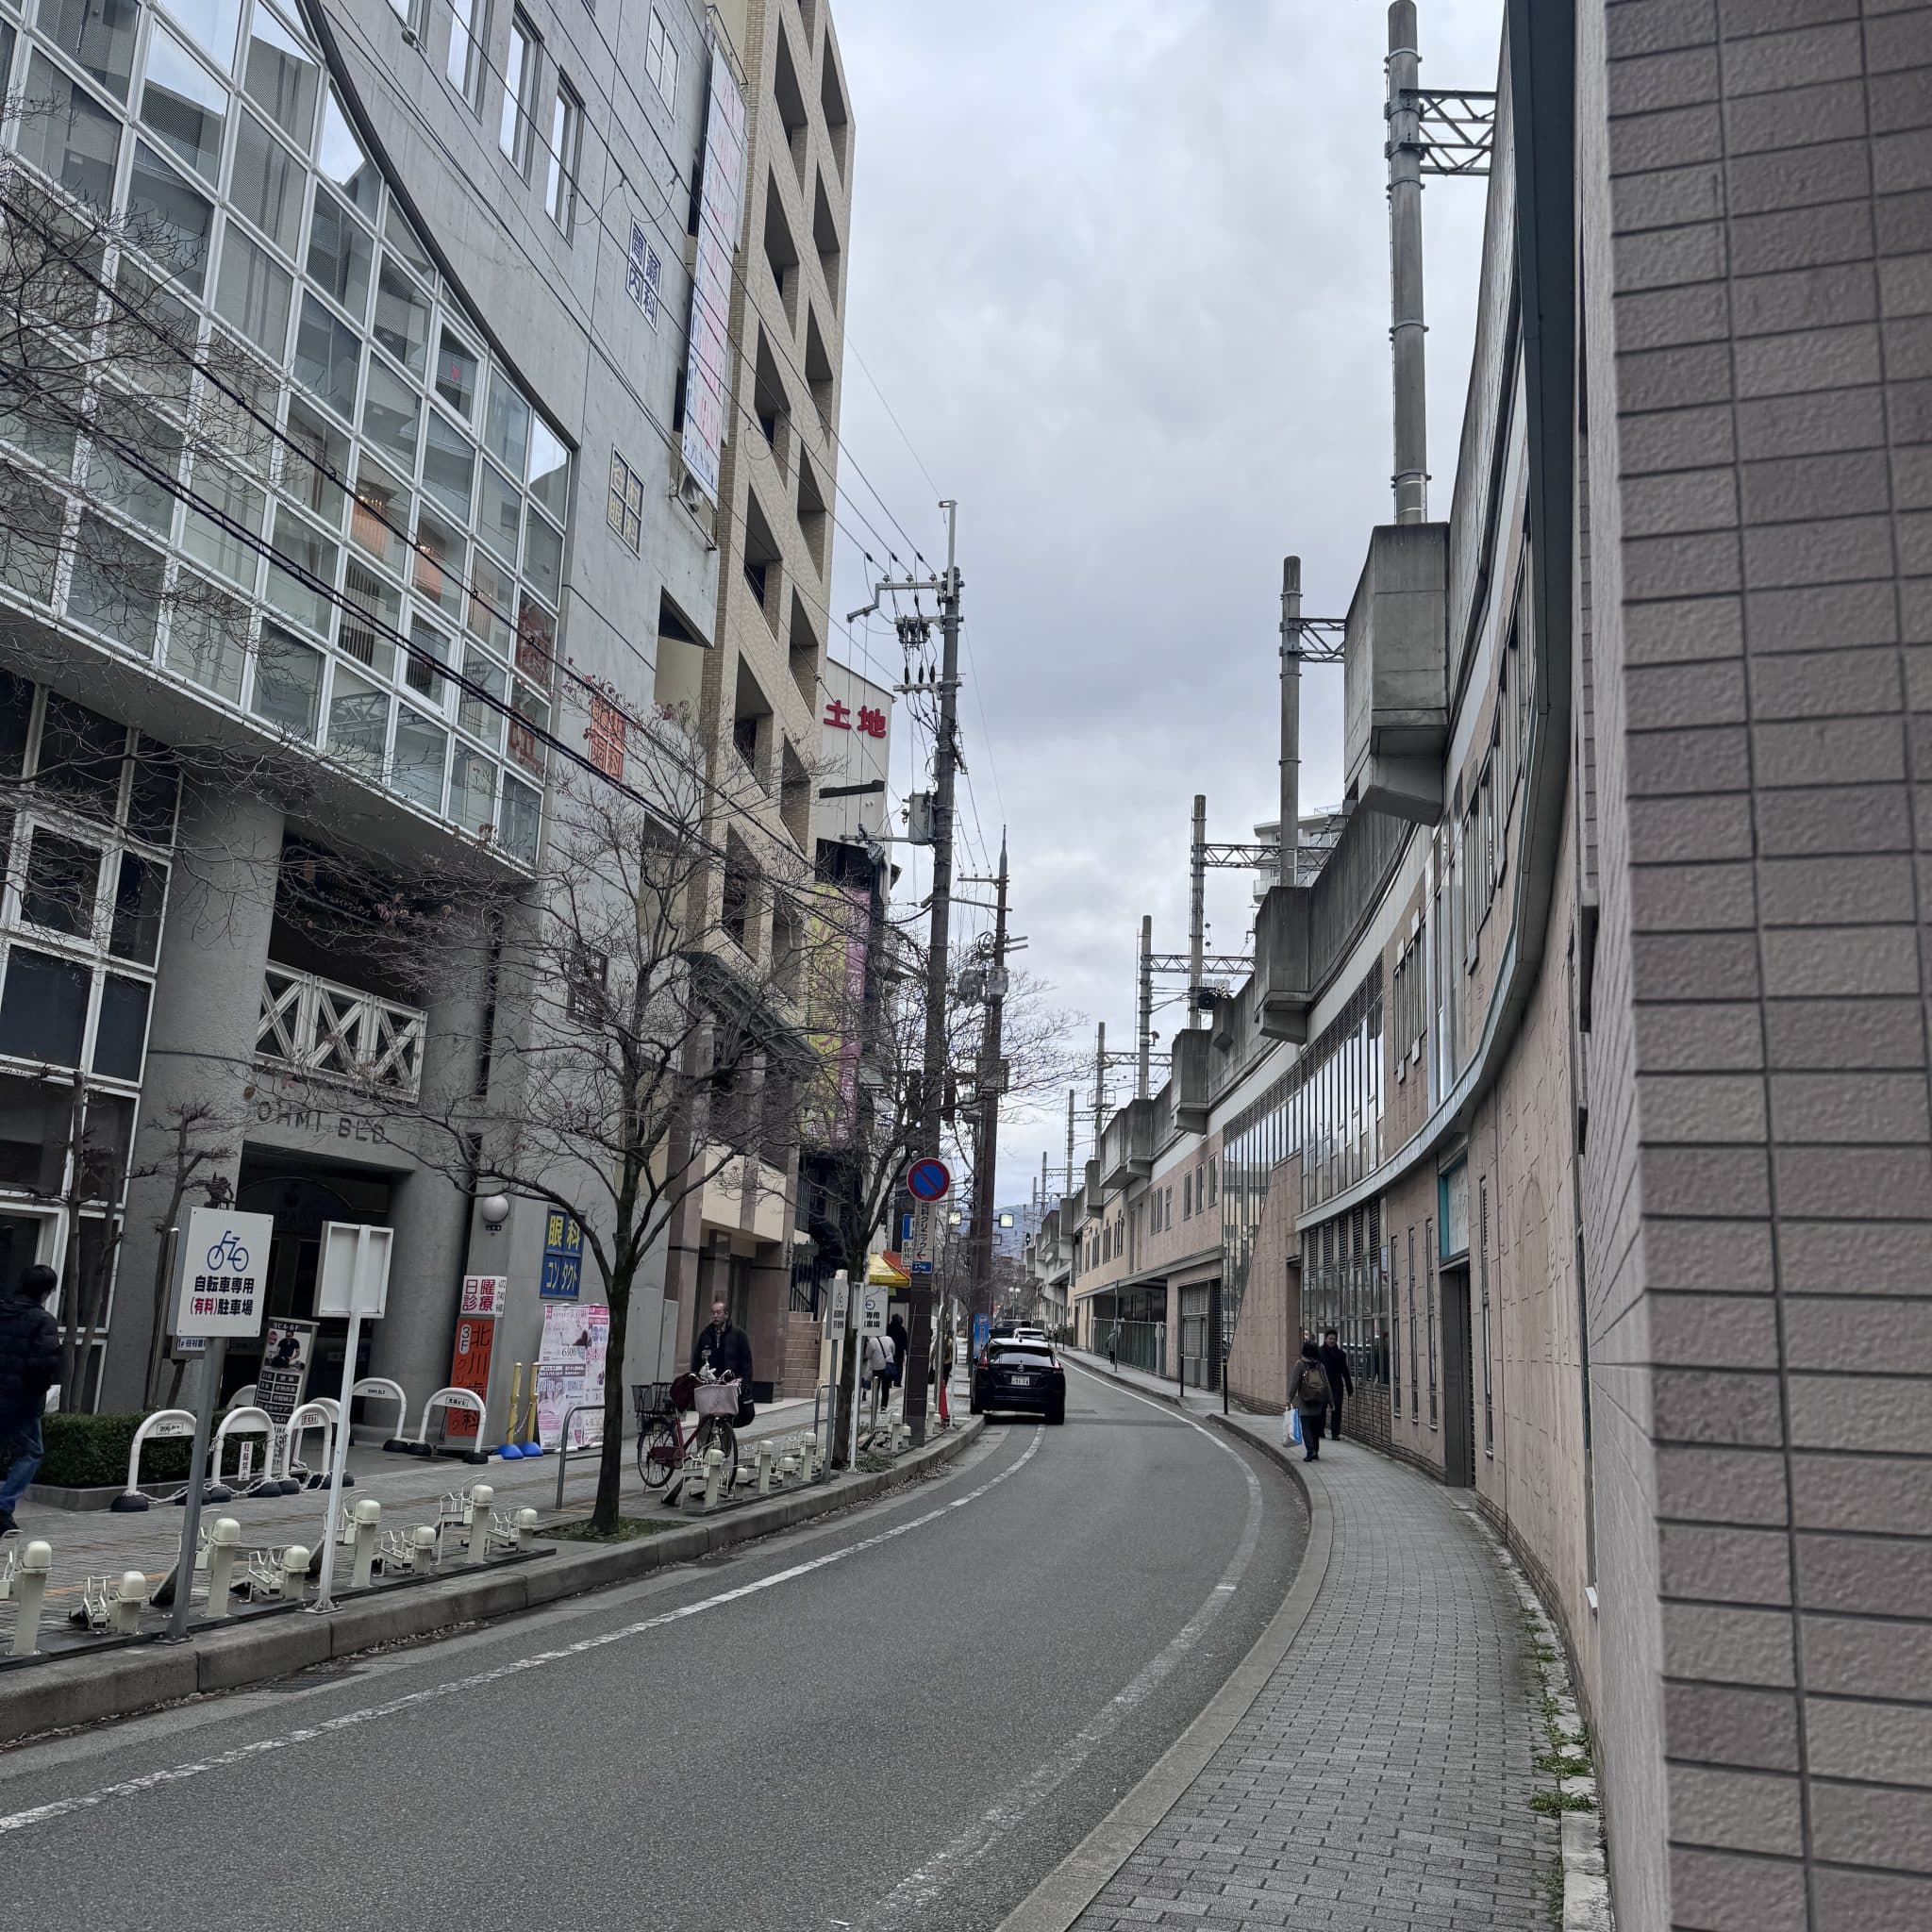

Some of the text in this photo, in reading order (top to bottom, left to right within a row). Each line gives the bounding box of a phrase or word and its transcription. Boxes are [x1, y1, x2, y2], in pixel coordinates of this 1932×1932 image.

[609, 495, 638, 549] 眼科
[824, 699, 886, 739] 土地
[338, 1117, 385, 1144] BLD
[548, 1215, 581, 1250] 眼科
[194, 1274, 255, 1293] 自転車専用
[465, 1279, 495, 1294] 日曜
[546, 1261, 577, 1291] コンタクト
[190, 1297, 253, 1315] (有料)駐車場
[462, 1294, 493, 1311] 診療
[460, 1325, 471, 1351] 3F
